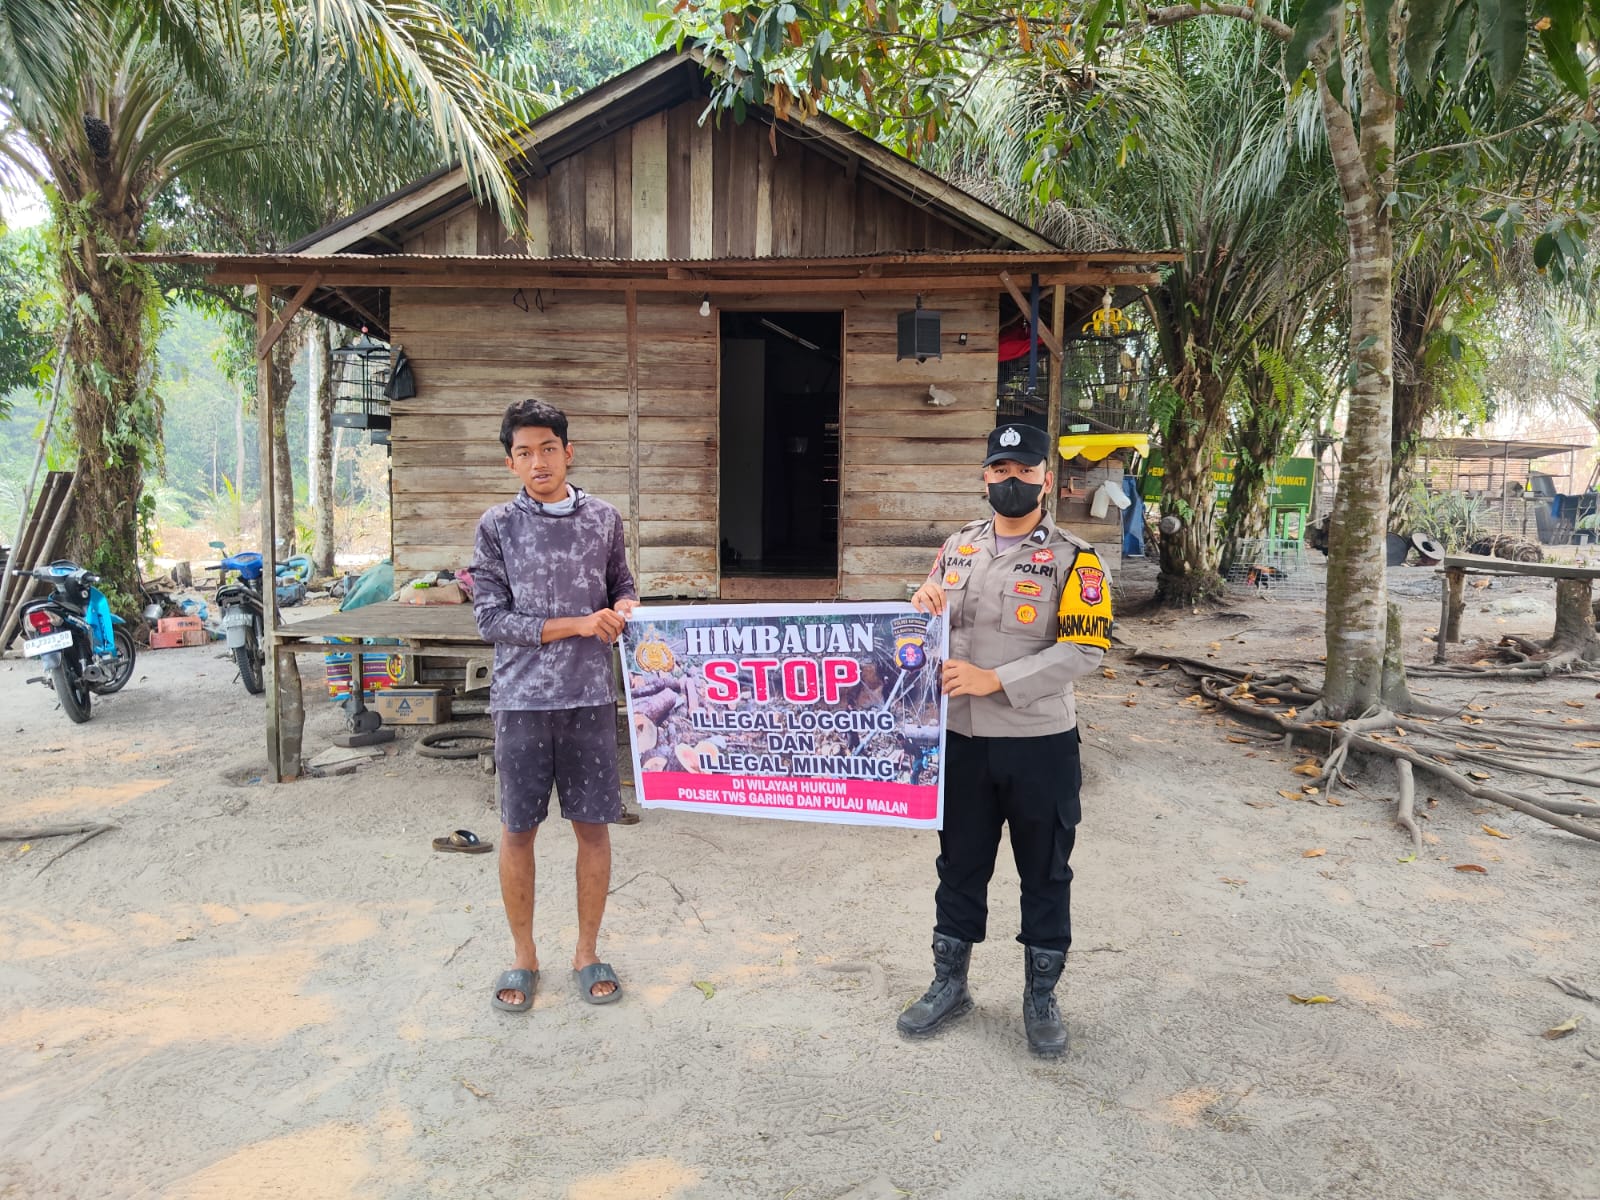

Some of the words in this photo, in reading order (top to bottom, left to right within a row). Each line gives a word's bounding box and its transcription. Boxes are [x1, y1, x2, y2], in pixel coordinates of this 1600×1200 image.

[1267, 476, 1307, 487] MAWATI
[946, 557, 972, 568] ZAKA
[1013, 563, 1054, 578] POLRI
[685, 622, 875, 656] HIMBAUAN
[703, 658, 861, 703] STOP
[692, 712, 782, 730] ILLEGAL
[788, 712, 893, 731] LOGGING
[769, 733, 814, 752] DAN
[699, 754, 788, 773] ILLEGAL
[793, 755, 894, 778] MINNING
[732, 778, 745, 789] DI
[747, 780, 798, 792] WILAYAH
[800, 782, 847, 795] HUKUM
[678, 787, 720, 801] POLSEK
[721, 790, 746, 803] TWS
[748, 791, 795, 806] GARING
[797, 794, 823, 808] DAN
[824, 796, 864, 811] PULAU
[866, 798, 908, 815] MALAN
